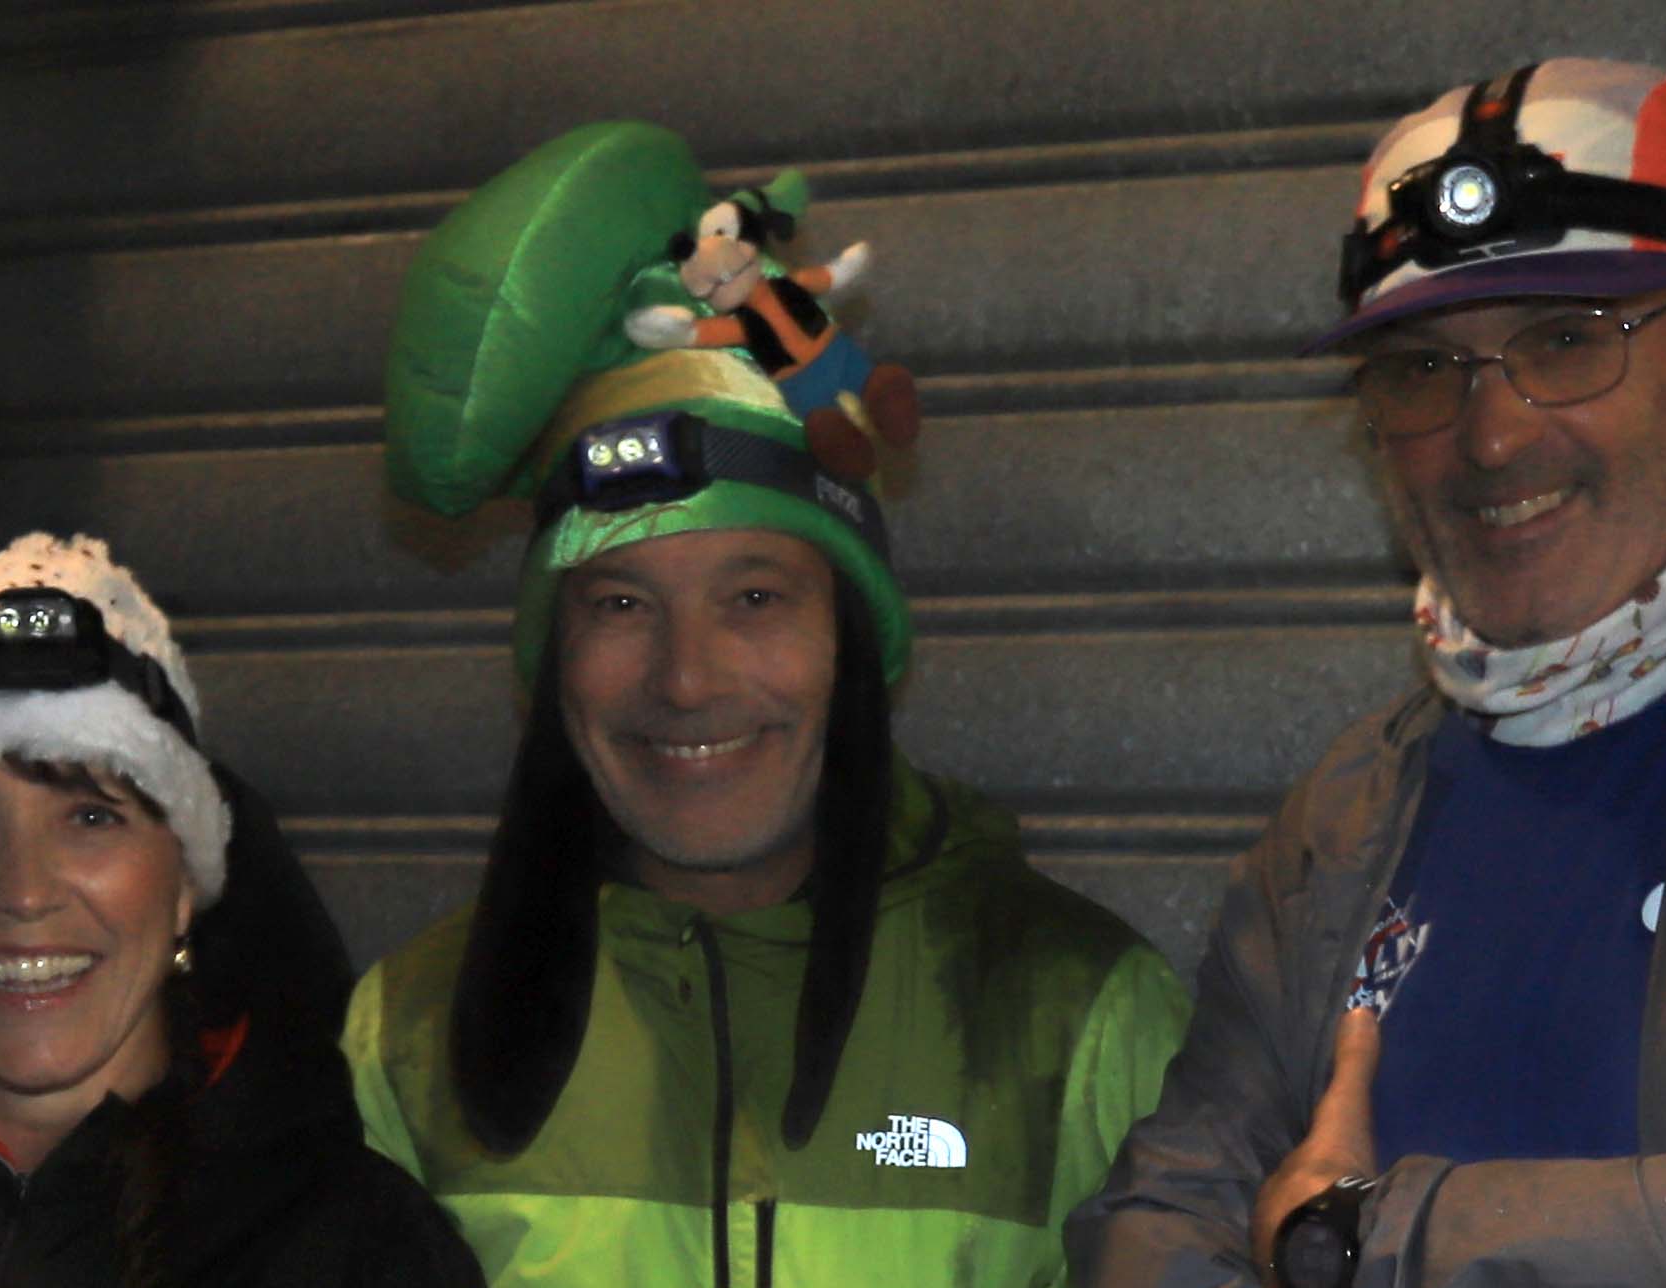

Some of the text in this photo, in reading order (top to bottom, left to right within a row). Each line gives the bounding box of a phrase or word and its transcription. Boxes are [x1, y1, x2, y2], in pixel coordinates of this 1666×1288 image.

[887, 1114, 929, 1133] THE
[856, 1131, 929, 1150] NORTH
[875, 1148, 927, 1167] FACE
